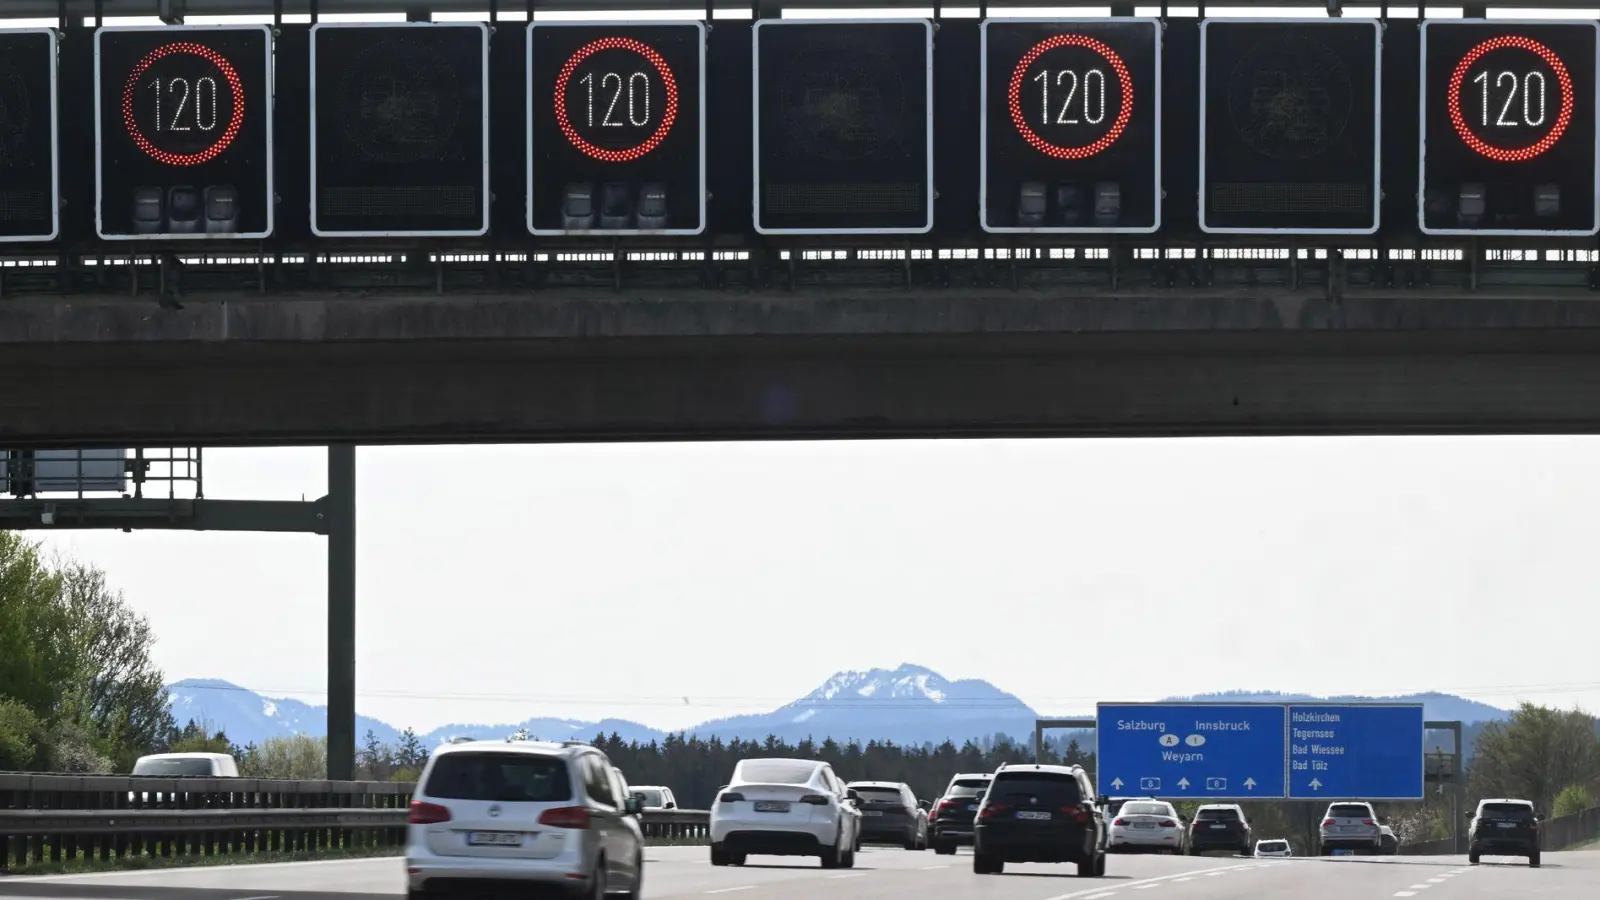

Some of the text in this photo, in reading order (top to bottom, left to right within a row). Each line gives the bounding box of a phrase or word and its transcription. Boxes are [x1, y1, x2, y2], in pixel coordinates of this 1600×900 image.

[579, 72, 652, 128] 120
[1033, 69, 1107, 126] 120
[1473, 70, 1548, 127] 120
[147, 77, 219, 132] 120
[1292, 711, 1341, 722] Holzkirchen
[1117, 720, 1250, 732] Salzburg Innsbruck
[1292, 727, 1335, 741] Tegernsee
[1165, 736, 1173, 745] A
[1292, 744, 1345, 755] Bad Wiessee
[1161, 751, 1204, 763] Weyarn
[1292, 760, 1308, 770] Bad
